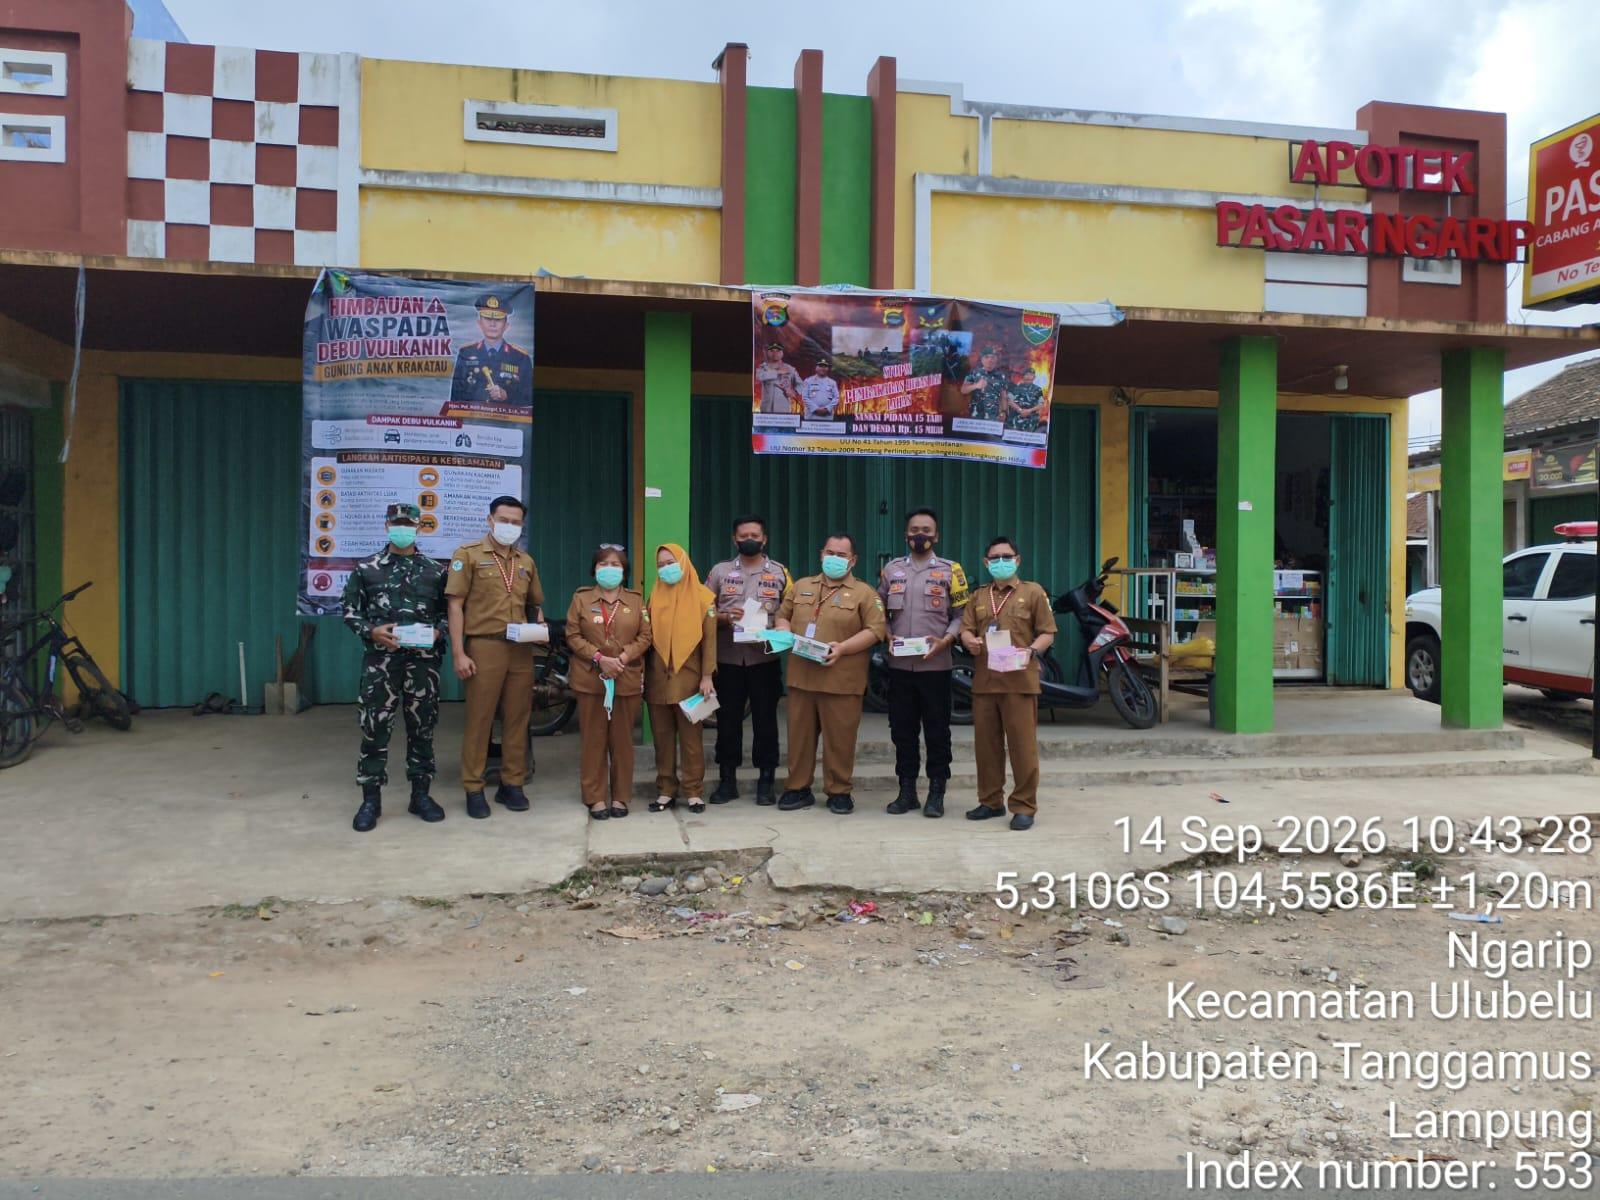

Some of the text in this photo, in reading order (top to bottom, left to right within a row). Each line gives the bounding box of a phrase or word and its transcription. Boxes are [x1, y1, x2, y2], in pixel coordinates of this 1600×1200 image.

[1292, 139, 1474, 194] APOTEK
[1216, 201, 1535, 263] PASAR NGARIP
[1536, 222, 1590, 248] CABANG
[1557, 268, 1578, 284] No
[330, 296, 425, 317] HIMBAUAN
[325, 315, 450, 340] WASPADA
[317, 338, 453, 363] DEBU VULKANIK
[324, 360, 448, 378] GUNUNG ANAK KRAKATAU
[371, 416, 457, 427] DAMPAK DEBU VULKANIK
[884, 413, 912, 422] PIDANA
[915, 414, 924, 422] 15
[852, 424, 868, 432] DAN
[870, 424, 895, 432] DENDA
[914, 425, 923, 433] 15
[342, 454, 380, 462] LANGKAH
[381, 455, 429, 465] ANTISIPASI
[440, 457, 502, 468] KESELAMATAN
